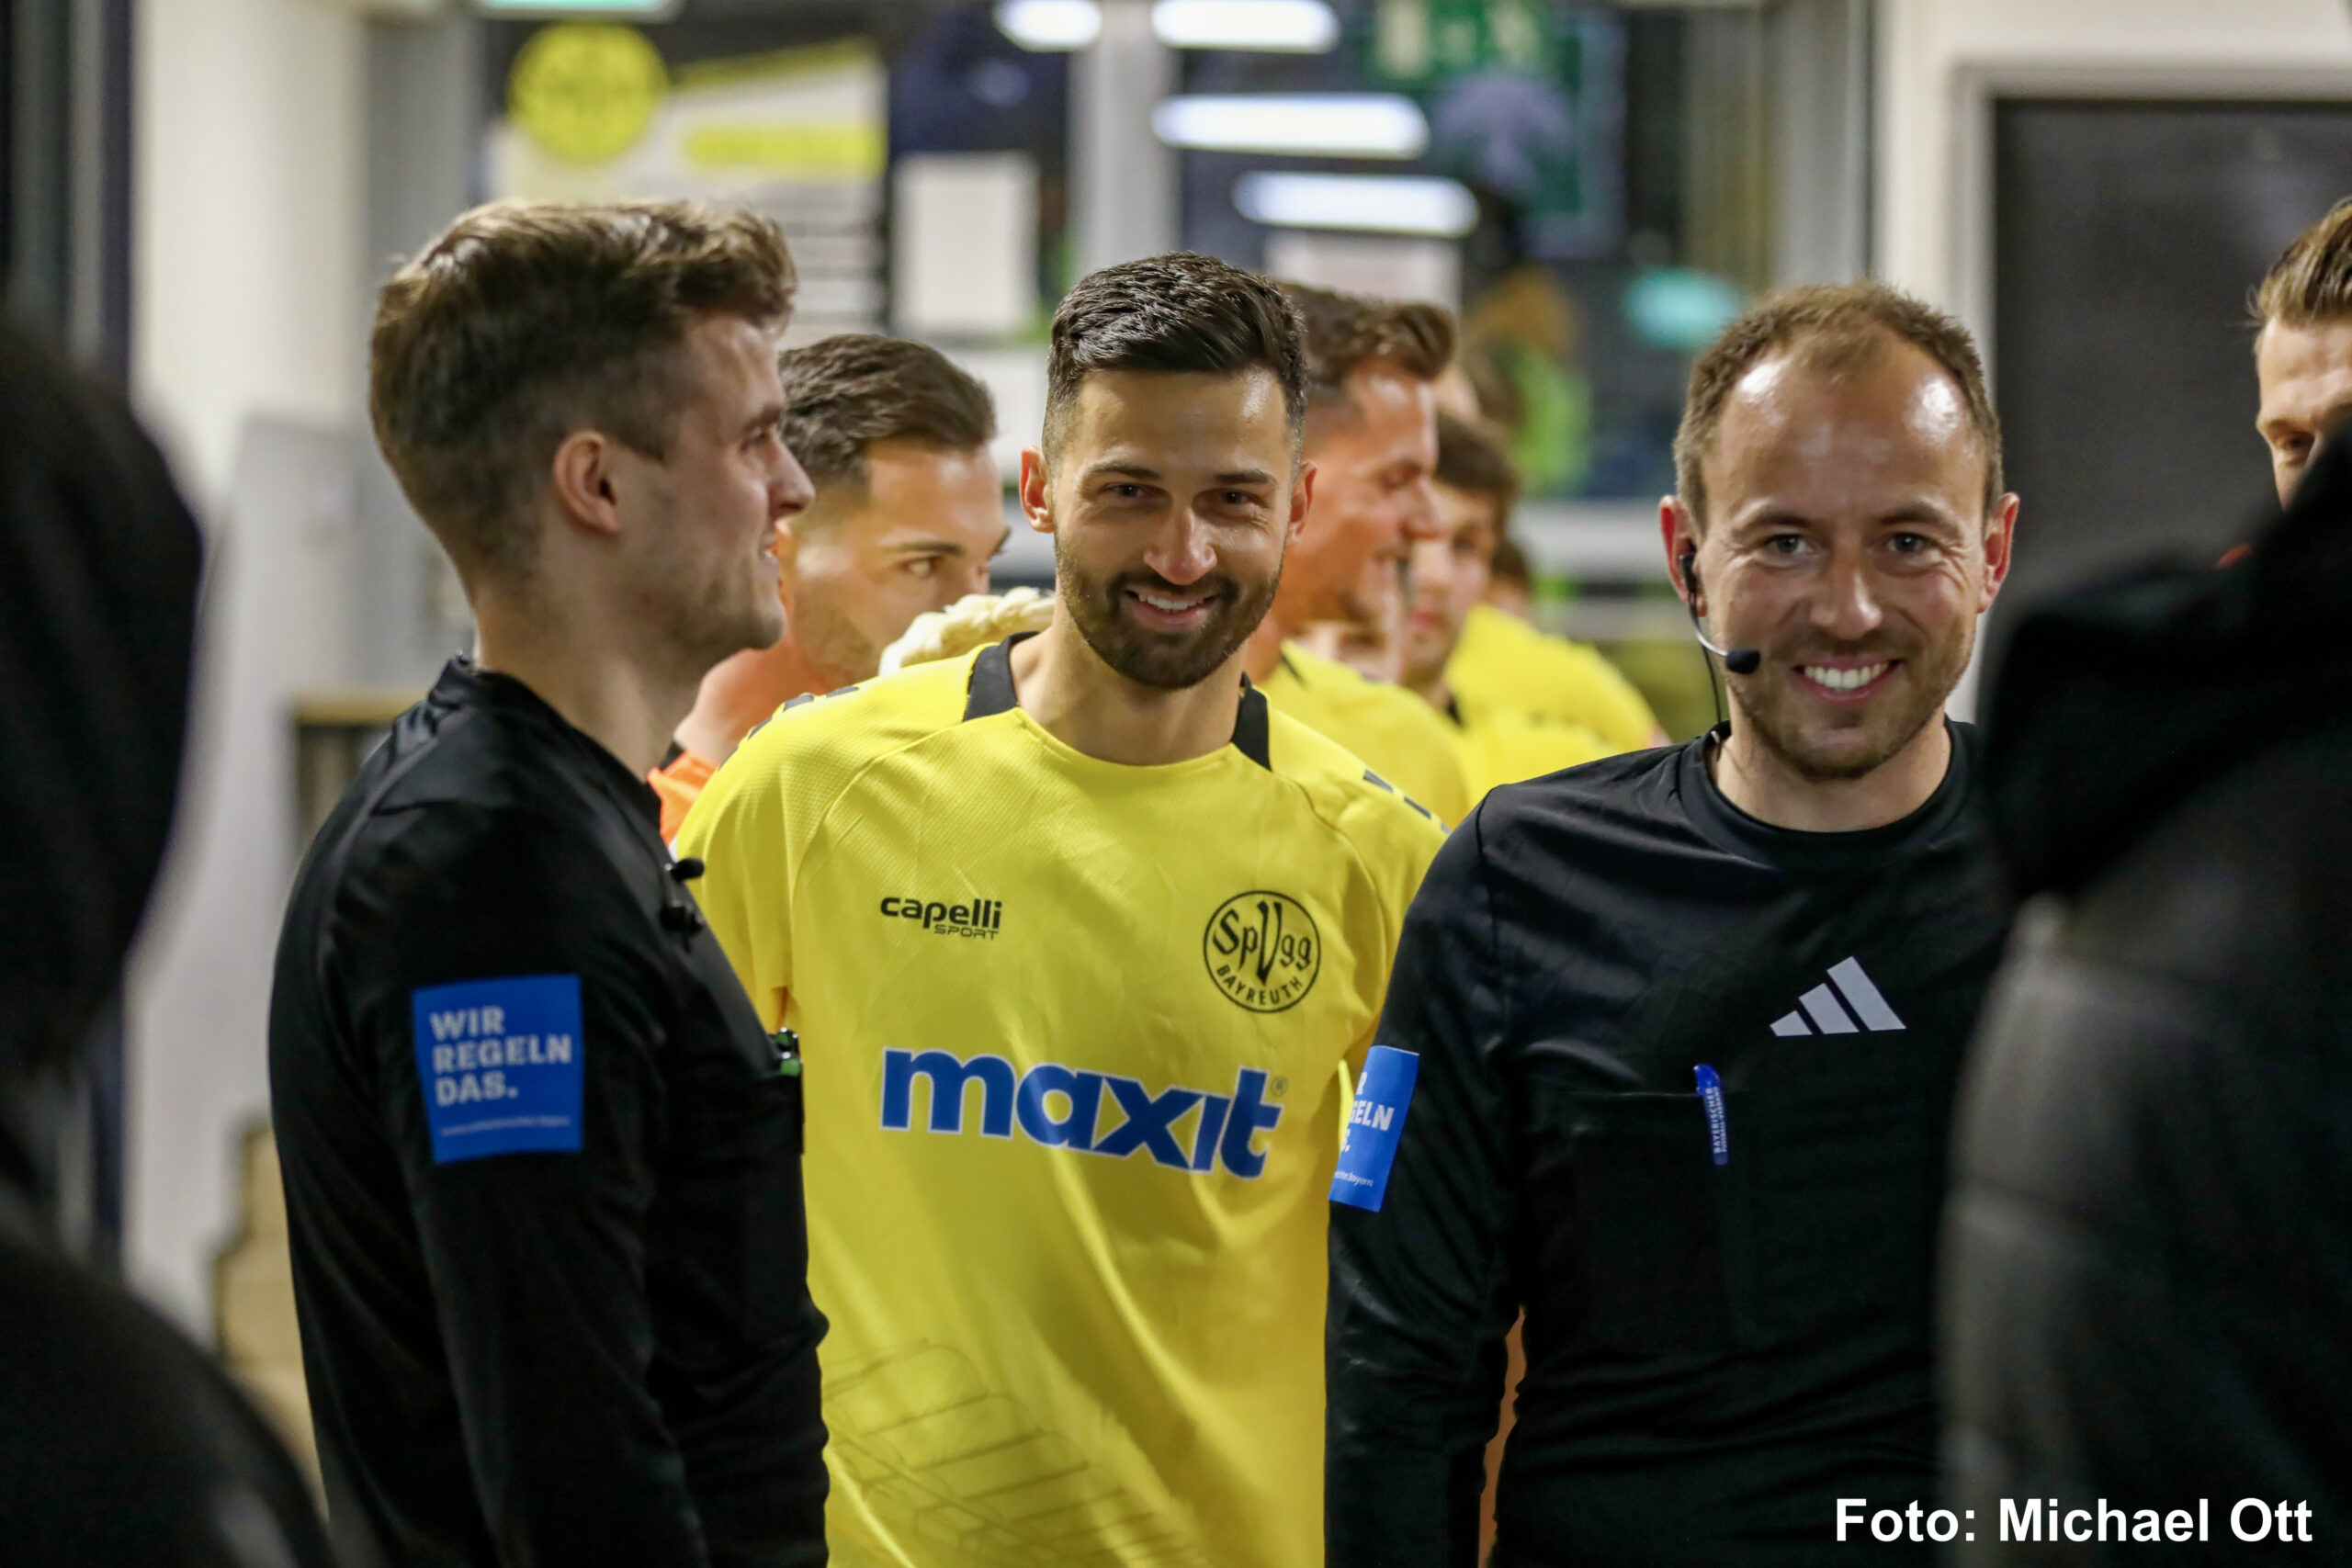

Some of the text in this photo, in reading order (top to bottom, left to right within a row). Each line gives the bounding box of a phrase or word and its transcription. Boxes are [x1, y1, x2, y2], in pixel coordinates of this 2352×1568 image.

[880, 897, 1002, 929] capelli
[933, 923, 1000, 940] SPORT
[1213, 900, 1312, 987] SpVgg
[1216, 964, 1304, 1005] BAYREUTH
[429, 1005, 505, 1041] WIR
[432, 1033, 572, 1075] REGELN
[435, 1070, 519, 1108] DAS.
[878, 1046, 1283, 1179] maxit
